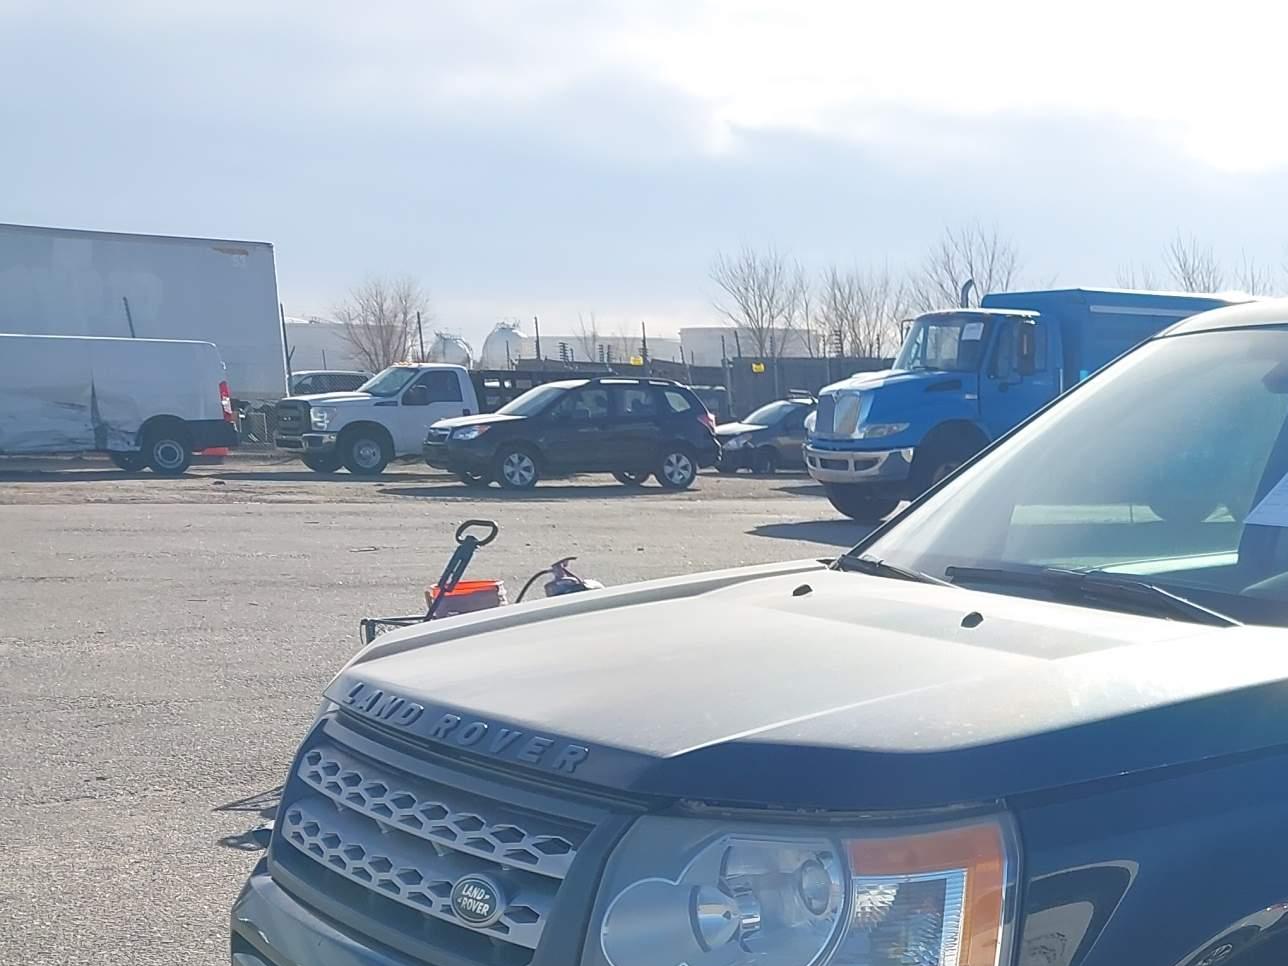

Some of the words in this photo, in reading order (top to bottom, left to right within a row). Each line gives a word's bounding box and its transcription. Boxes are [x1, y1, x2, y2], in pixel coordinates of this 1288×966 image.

[345, 682, 425, 727] LAND
[430, 713, 592, 774] ROVER
[462, 884, 486, 900] LAND
[460, 897, 490, 917] ROVER
